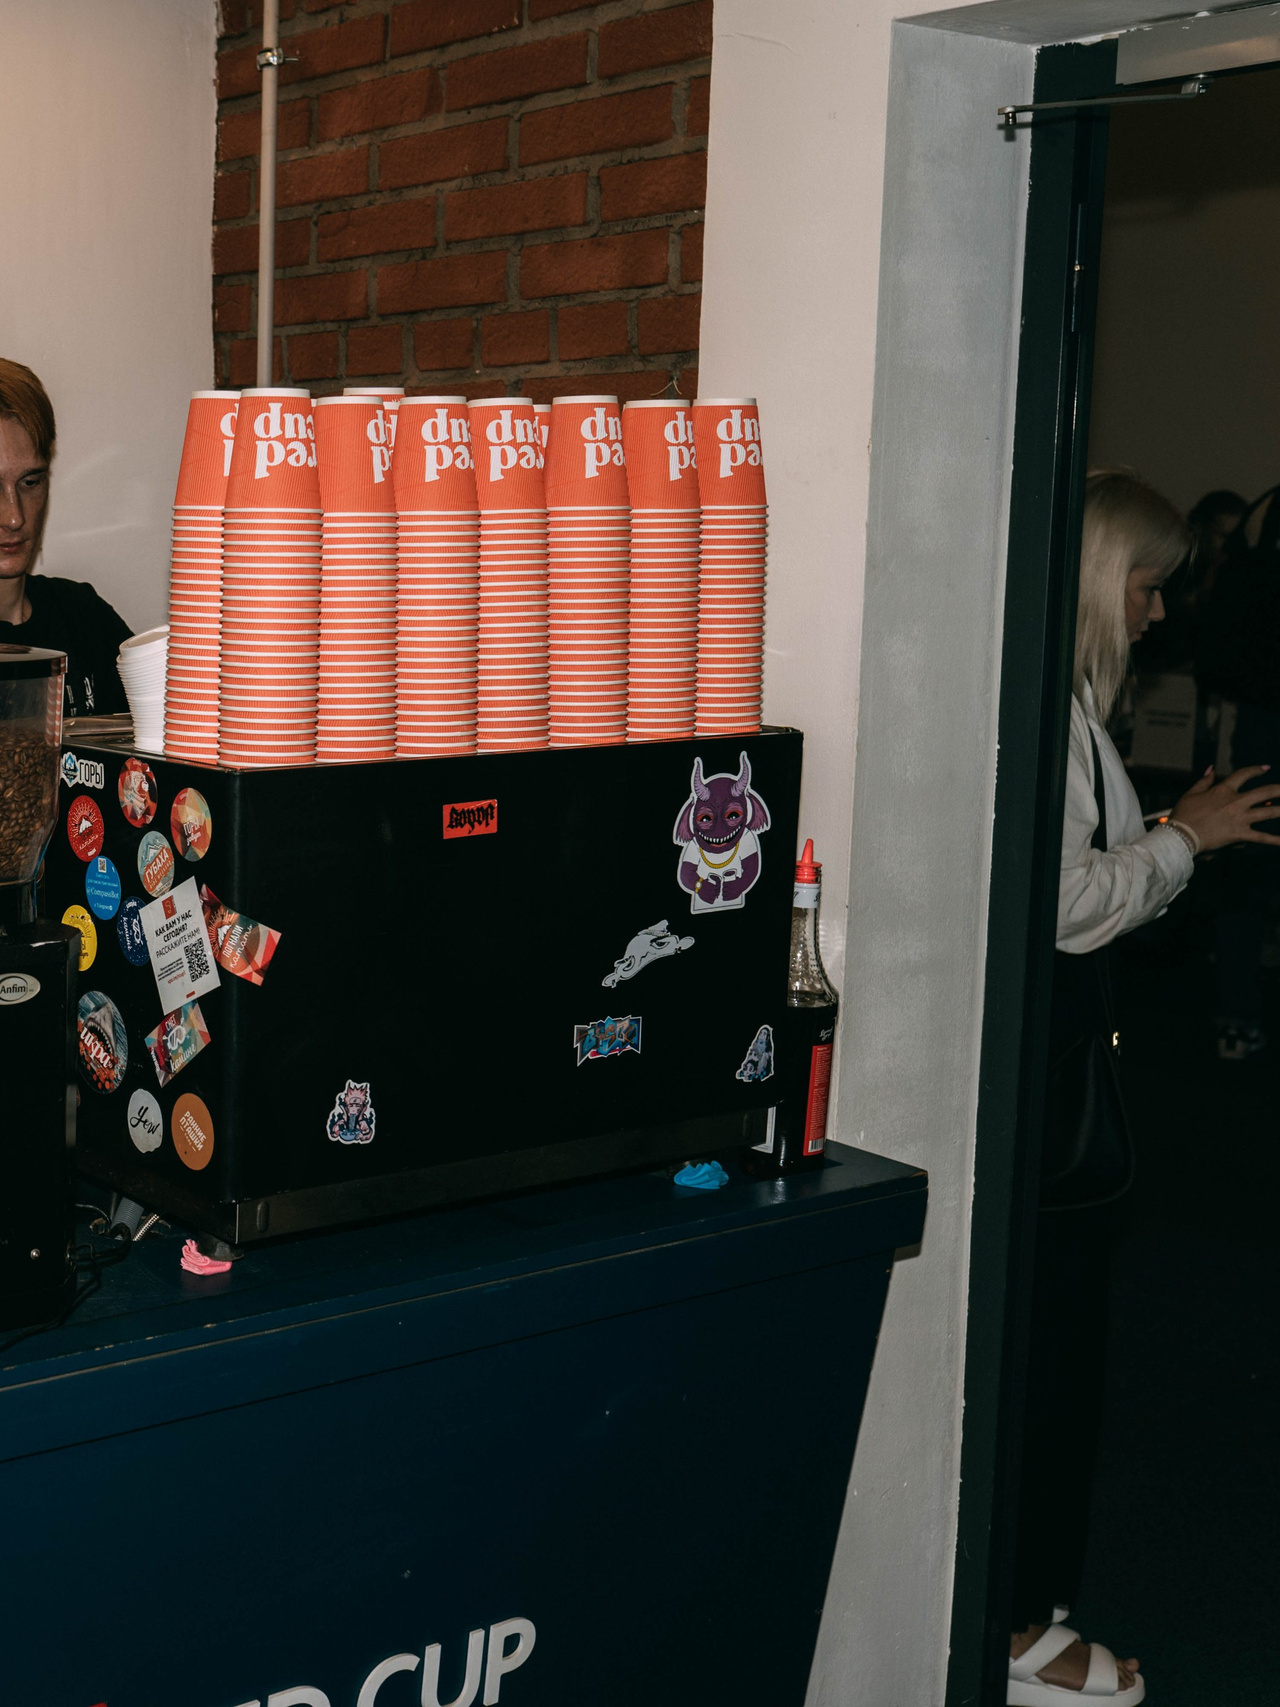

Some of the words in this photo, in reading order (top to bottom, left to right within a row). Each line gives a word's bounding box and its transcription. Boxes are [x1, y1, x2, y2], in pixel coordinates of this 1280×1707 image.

[79, 762, 103, 785] ГОРЫ
[145, 848, 169, 883] ГУБАХА
[155, 927, 166, 937] КАК
[165, 919, 177, 931] ВАМ
[181, 910, 192, 921] НАС
[163, 923, 188, 943] СЕГОДНЯ?
[222, 924, 244, 958] ПОГНАЛИ
[0, 984, 26, 994] Anfim
[80, 1027, 111, 1068] икра
[179, 1116, 203, 1151] ПТАШКИ
[184, 1110, 206, 1142] РАННИЕ
[357, 1617, 537, 1707] CUP
